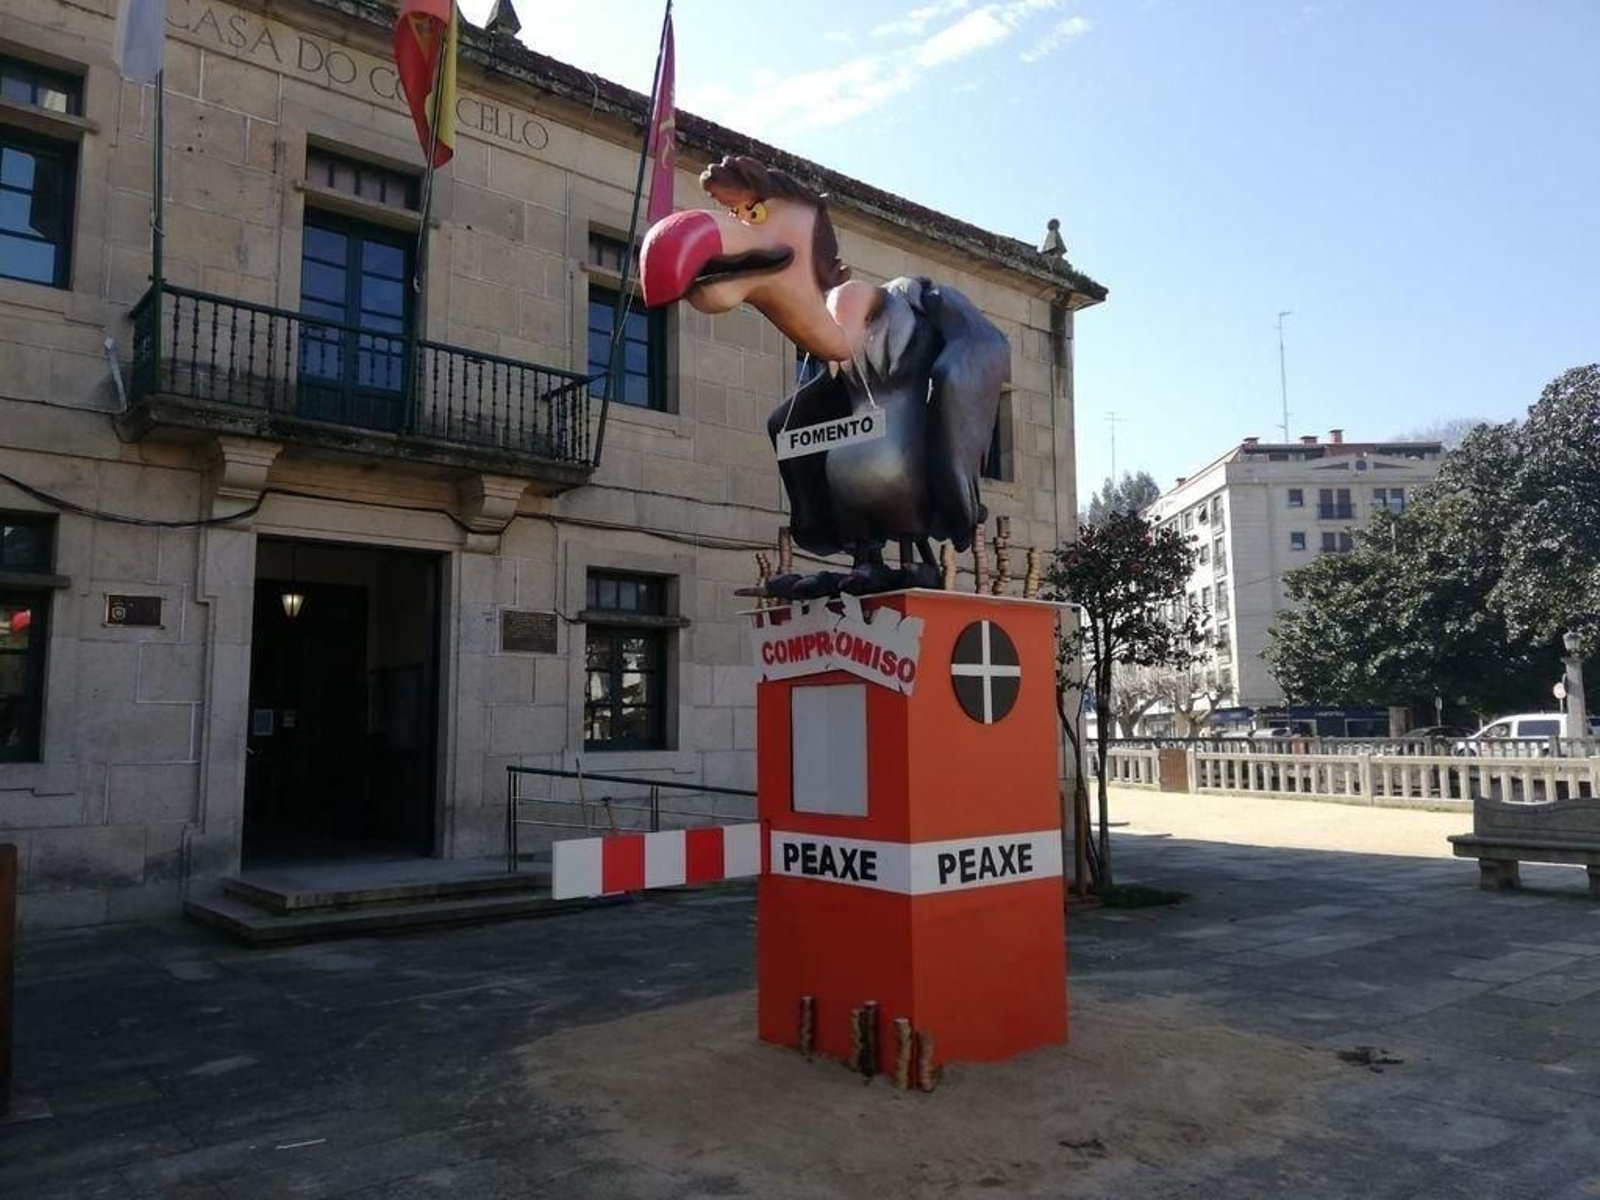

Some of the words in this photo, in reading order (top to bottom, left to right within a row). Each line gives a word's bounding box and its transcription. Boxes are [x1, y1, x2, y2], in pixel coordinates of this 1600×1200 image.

[297, 37, 357, 84] DO
[369, 66, 549, 151] CCELLO
[789, 416, 874, 449] FOMENTO
[761, 631, 917, 683] COMPROMISO
[783, 842, 878, 882] PEAXE
[937, 843, 1034, 885] PEAXE
